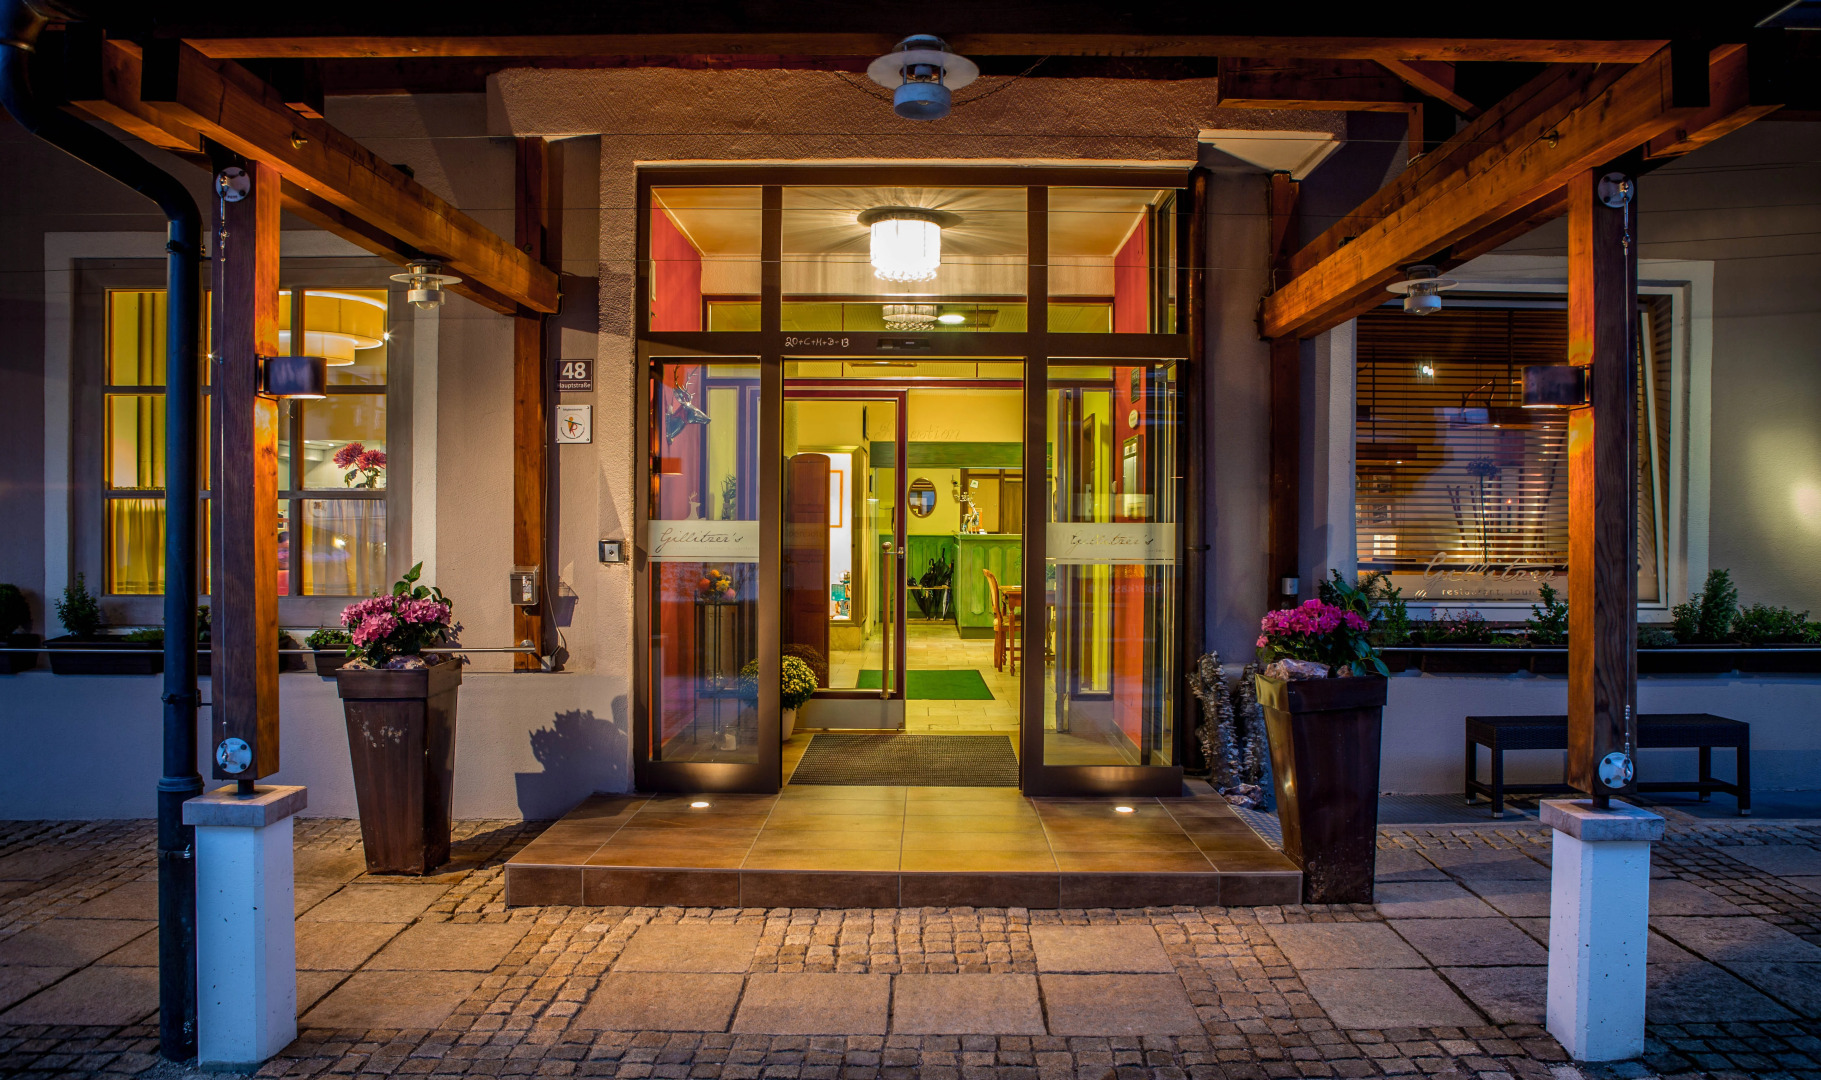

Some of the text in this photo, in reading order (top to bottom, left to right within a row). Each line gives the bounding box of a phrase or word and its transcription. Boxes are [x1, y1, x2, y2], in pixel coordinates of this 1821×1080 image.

[562, 362, 586, 379] 48
[655, 528, 744, 553] Gillitzer's
[1415, 552, 1569, 601] Gillitzer'
